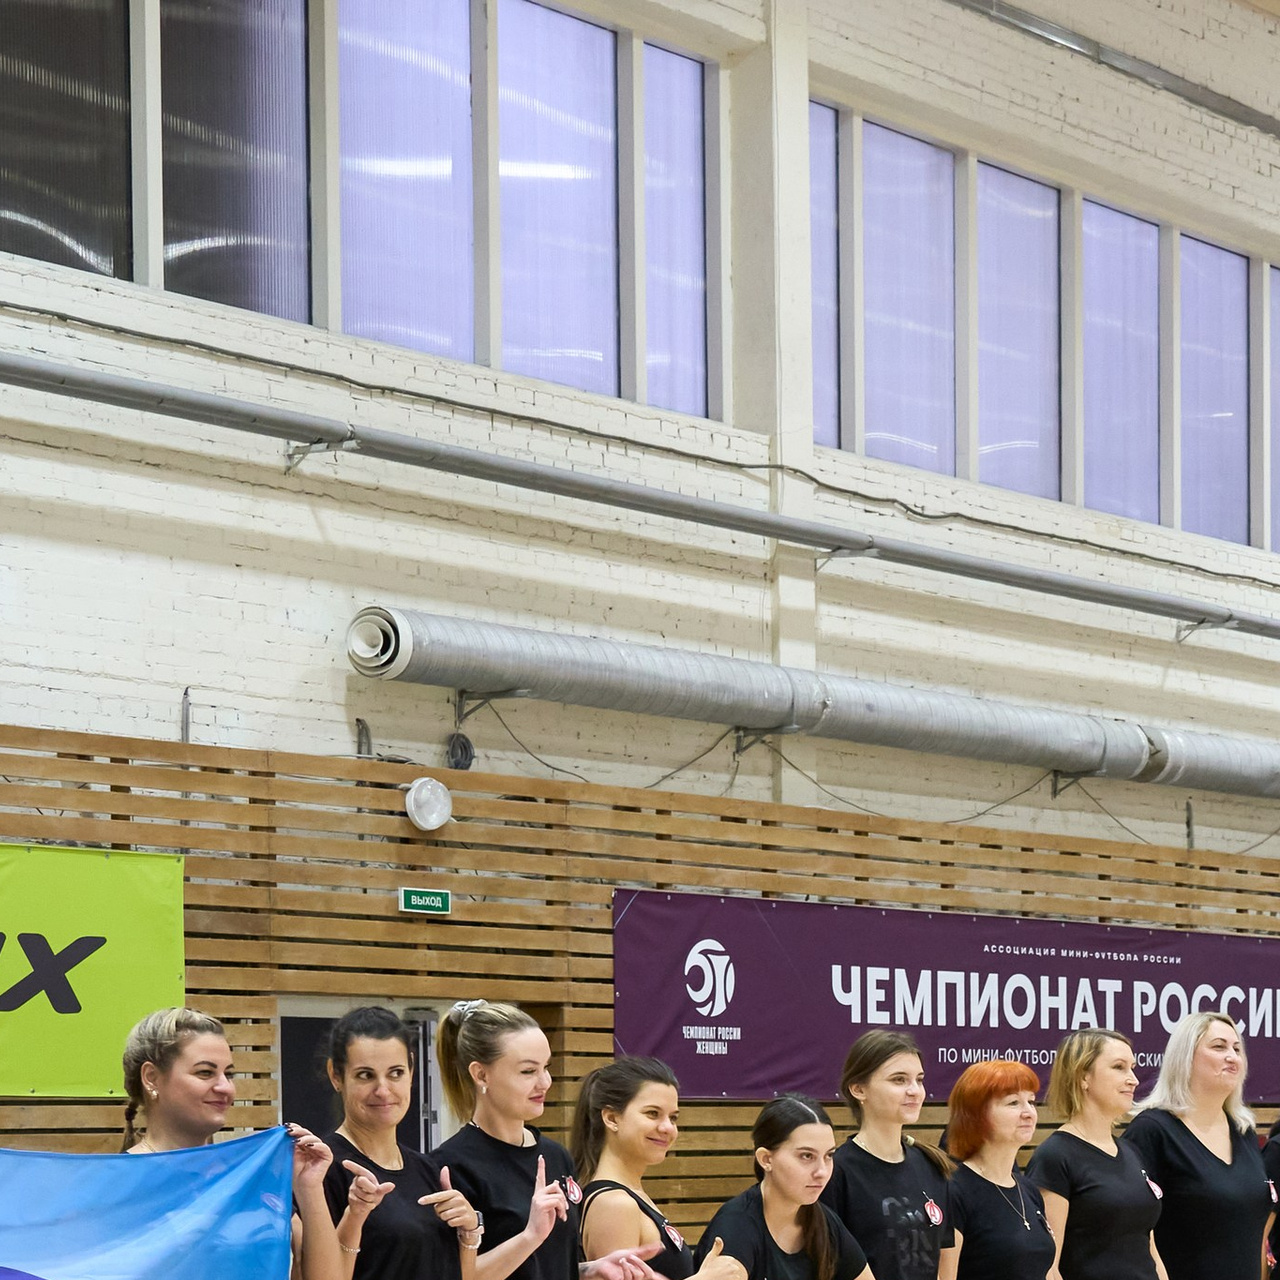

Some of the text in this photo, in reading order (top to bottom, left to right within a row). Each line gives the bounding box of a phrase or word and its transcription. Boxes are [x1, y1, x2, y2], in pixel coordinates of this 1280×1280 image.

[411, 895, 442, 908] ВЫХОД
[983, 944, 1182, 965] АССОЦИАЦИЯ МИНИ-ФУТБОЛА РОССИИ
[831, 964, 1122, 1032] ЧЕМПИОНАТ
[938, 1048, 958, 1063] ПО
[962, 1048, 1057, 1065] МИНИ-ФУТБОЛ
